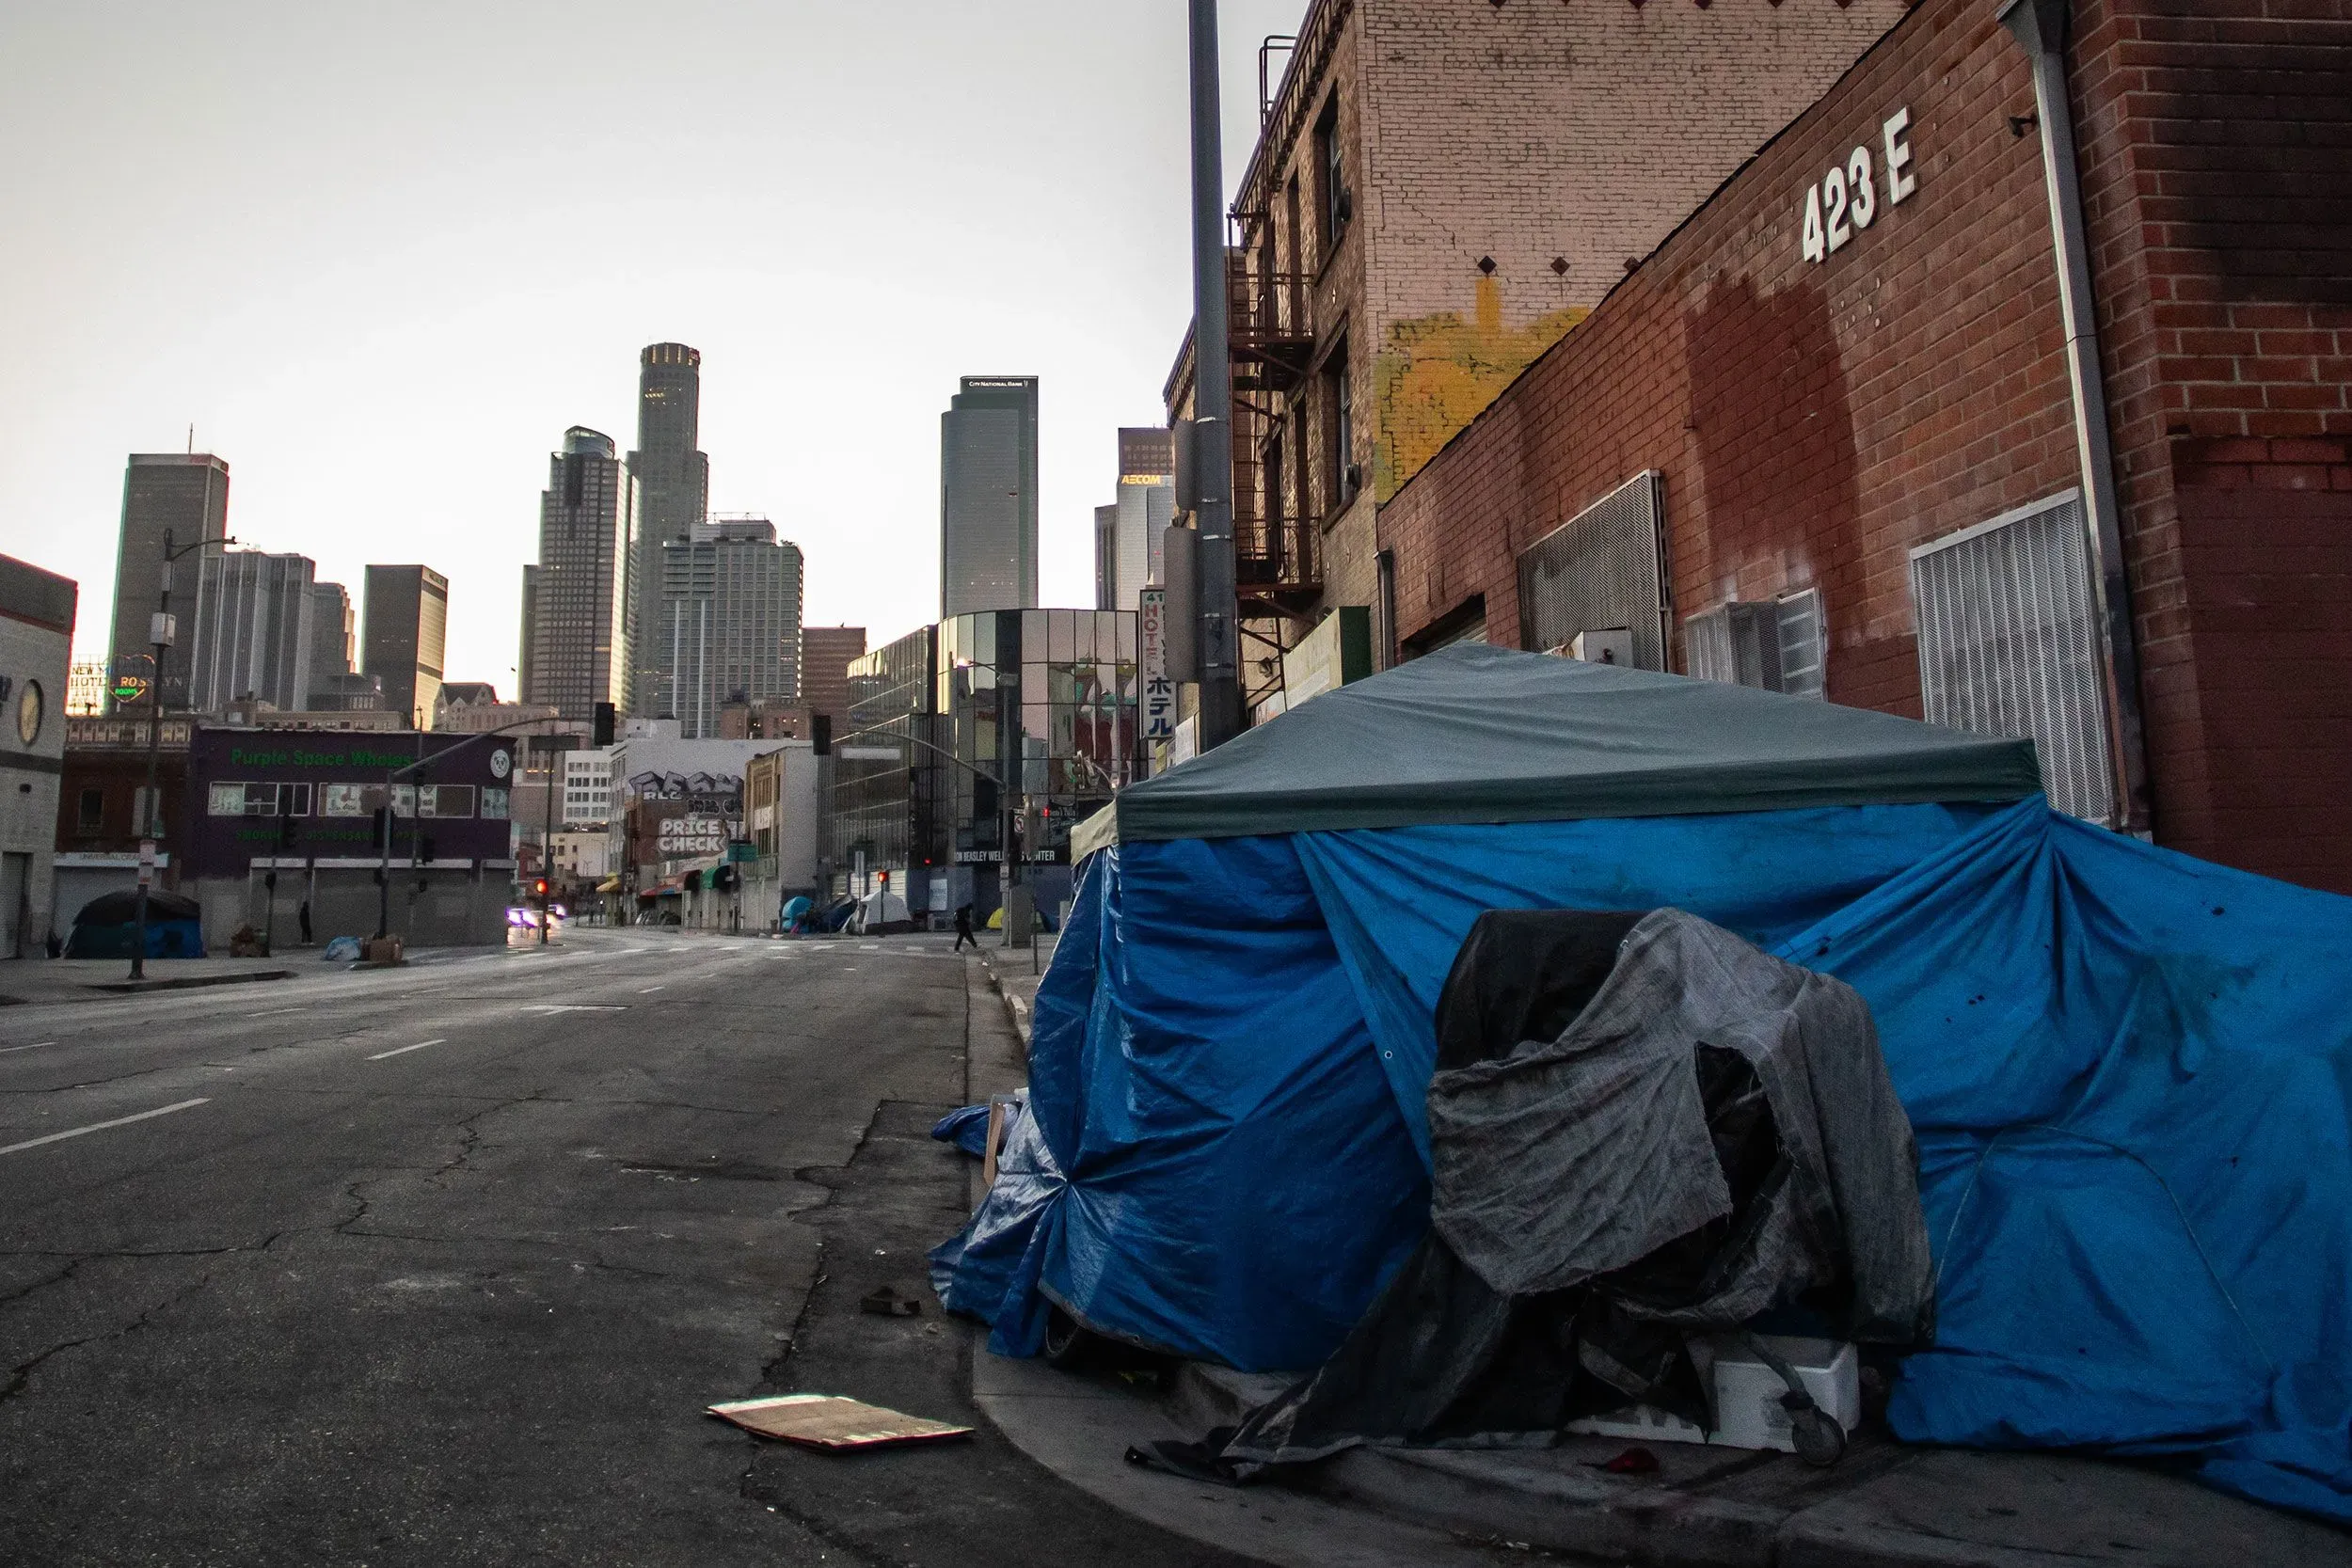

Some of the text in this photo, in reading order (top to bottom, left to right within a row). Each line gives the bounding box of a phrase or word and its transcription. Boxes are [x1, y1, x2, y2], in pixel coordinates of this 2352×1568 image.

[1803, 106, 1915, 263] 423 E
[1120, 474, 1161, 484] AECOM
[1144, 604, 1158, 674] HOTEL
[72, 666, 93, 675] NEW
[1147, 676, 1172, 736] ホテル
[230, 749, 287, 767] Purple
[293, 750, 345, 768] Space
[660, 819, 721, 836] PRICE
[659, 837, 721, 851] CHECK
[963, 850, 987, 862] BEASLEY
